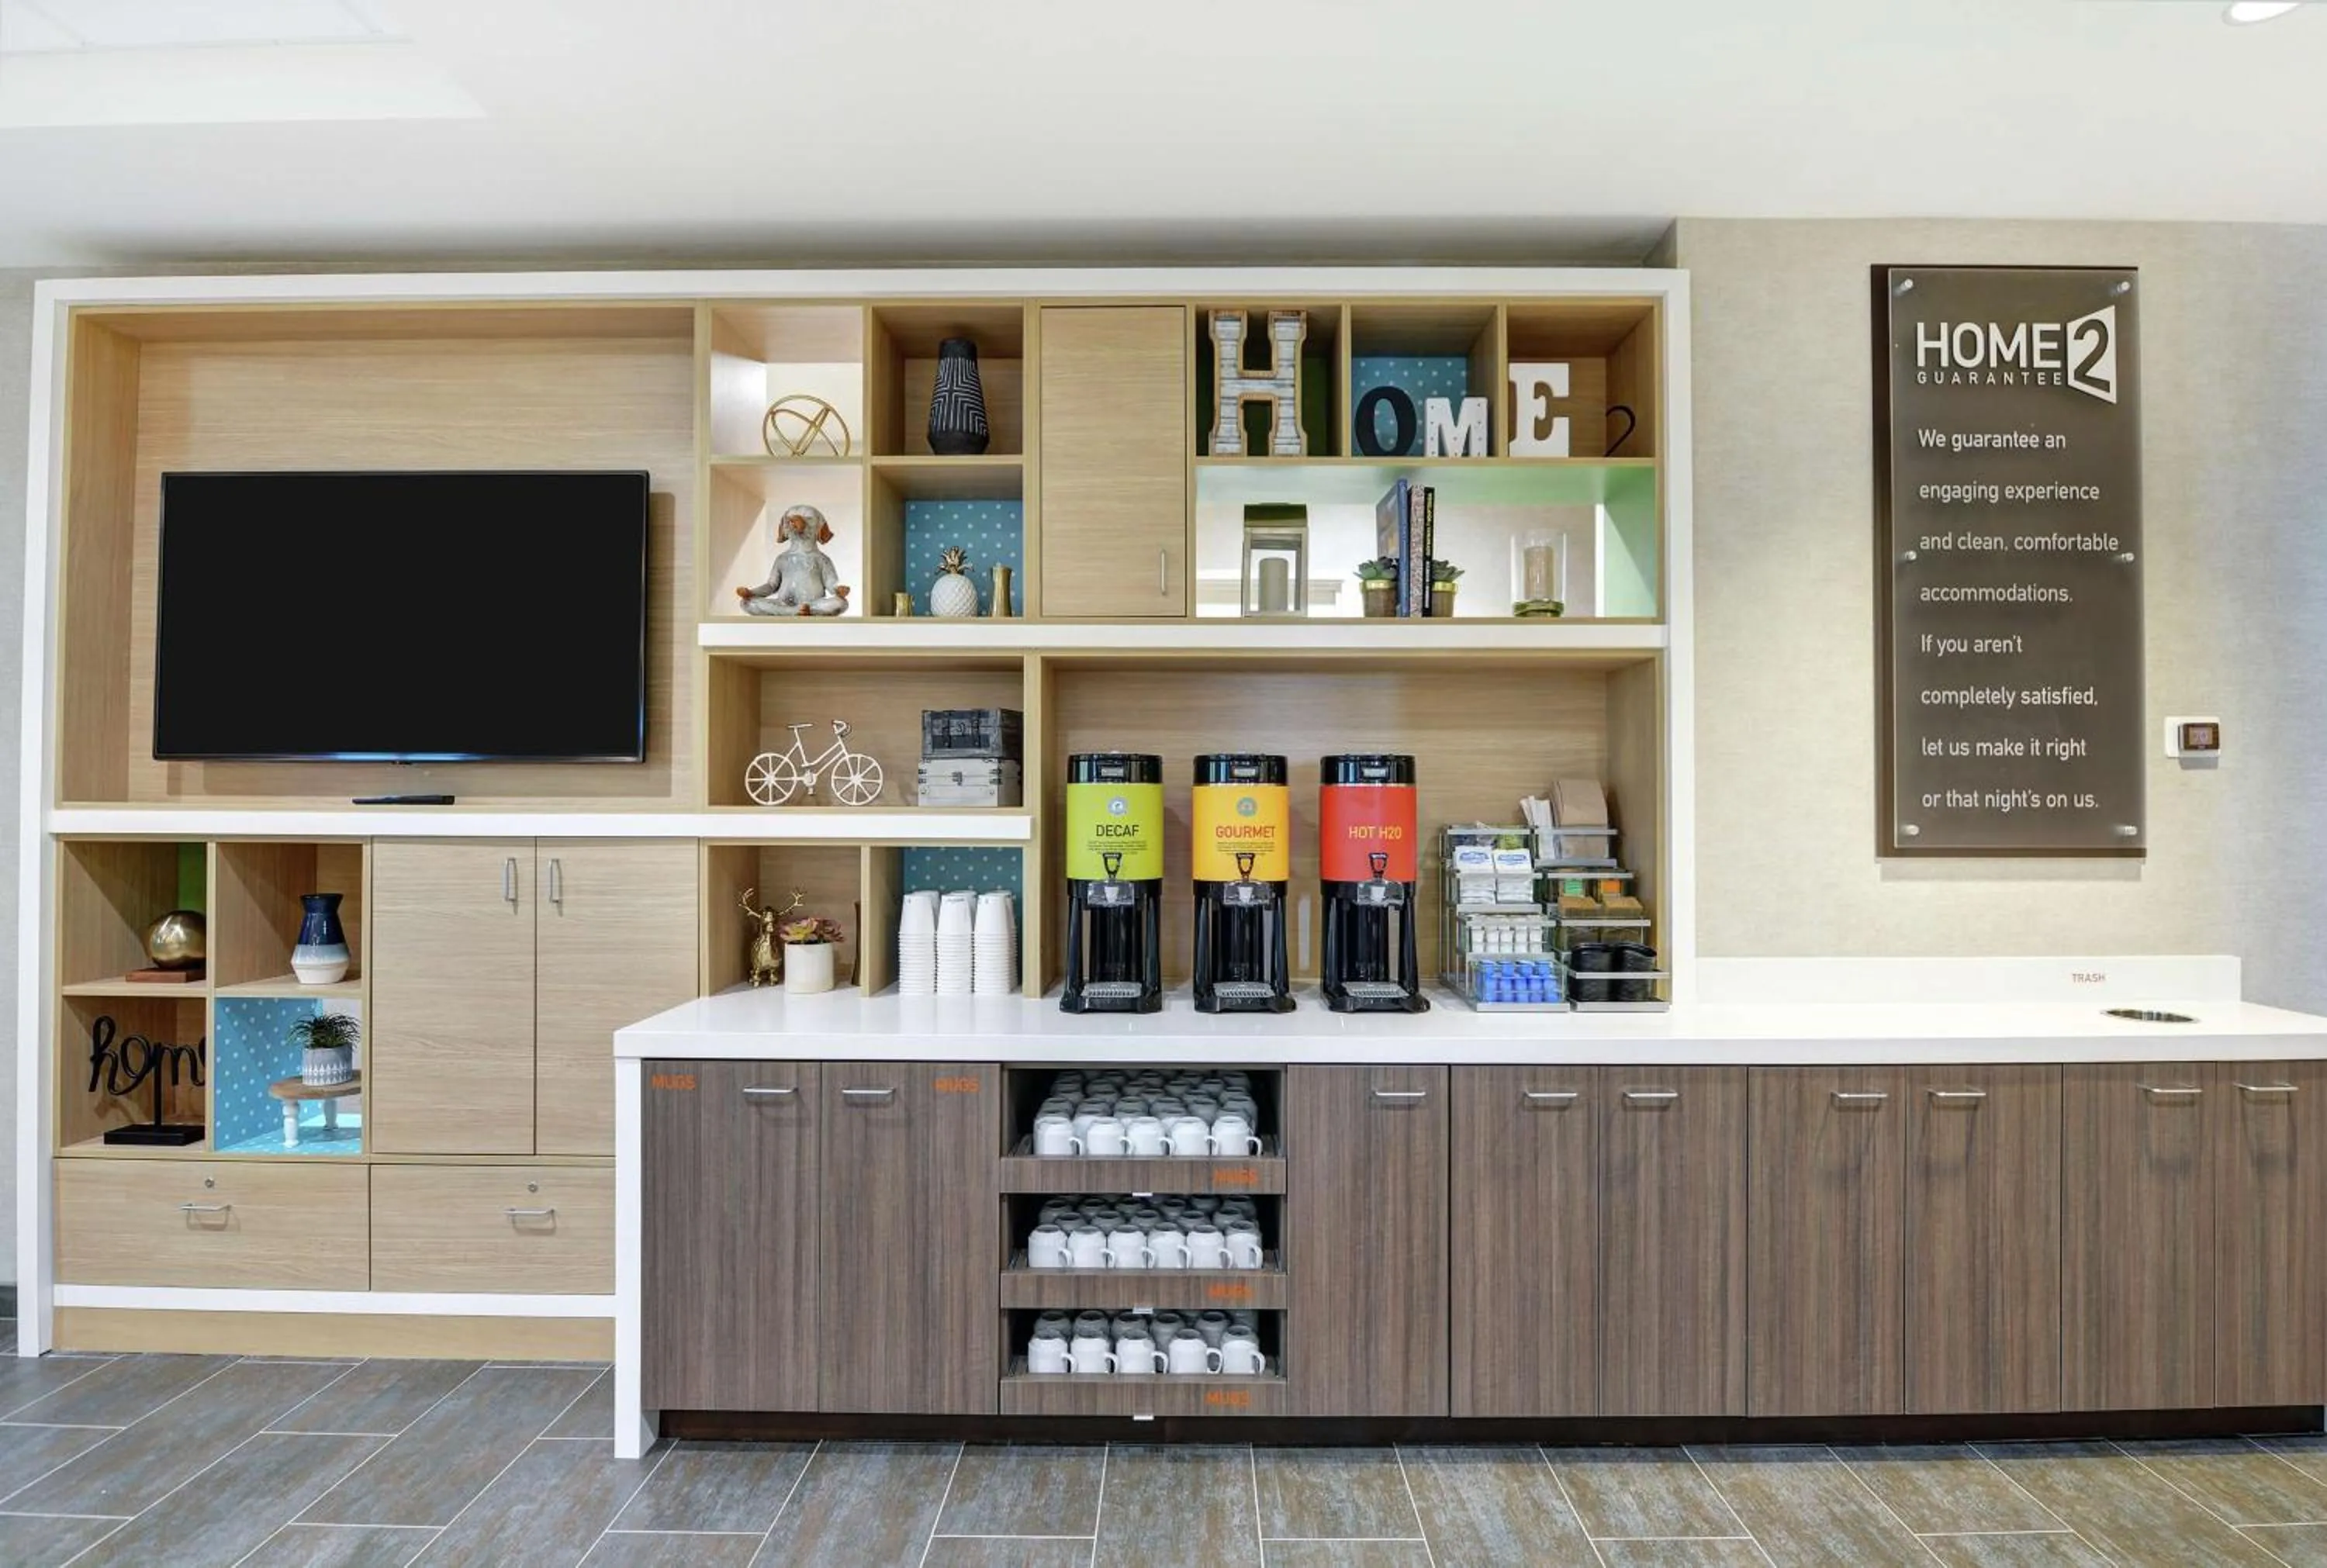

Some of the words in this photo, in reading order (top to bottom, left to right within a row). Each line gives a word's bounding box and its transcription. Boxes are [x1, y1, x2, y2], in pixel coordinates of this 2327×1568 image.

[1917, 371, 2062, 385] GUARANTEE
[1918, 429, 1946, 447] We
[1952, 430, 2039, 452] guarantee
[2045, 434, 2066, 448] an
[1920, 481, 1999, 503] engaging
[2005, 481, 2100, 503] experience
[1920, 532, 1952, 550] and
[2014, 533, 2118, 551] comfortable
[1920, 583, 2073, 603] accommodations.
[1921, 634, 1932, 653] If
[1937, 638, 1968, 657] you
[1973, 634, 2022, 653] aren't
[1921, 686, 2016, 710] completely
[1922, 737, 1944, 756] let
[1949, 742, 1970, 756] us
[1976, 737, 2024, 756] make
[2030, 737, 2041, 756] it
[2046, 737, 2087, 761] right
[1921, 793, 1941, 807] or
[1945, 789, 1980, 807] that
[1985, 789, 2041, 813] night's
[2045, 793, 2068, 808] on
[2073, 793, 2099, 808] us.
[1095, 824, 1139, 837] DECAF
[1215, 825, 1276, 838] GOURMET
[1349, 826, 1376, 839] HOT
[2072, 973, 2105, 983] TRASH
[88, 1015, 206, 1096] hom
